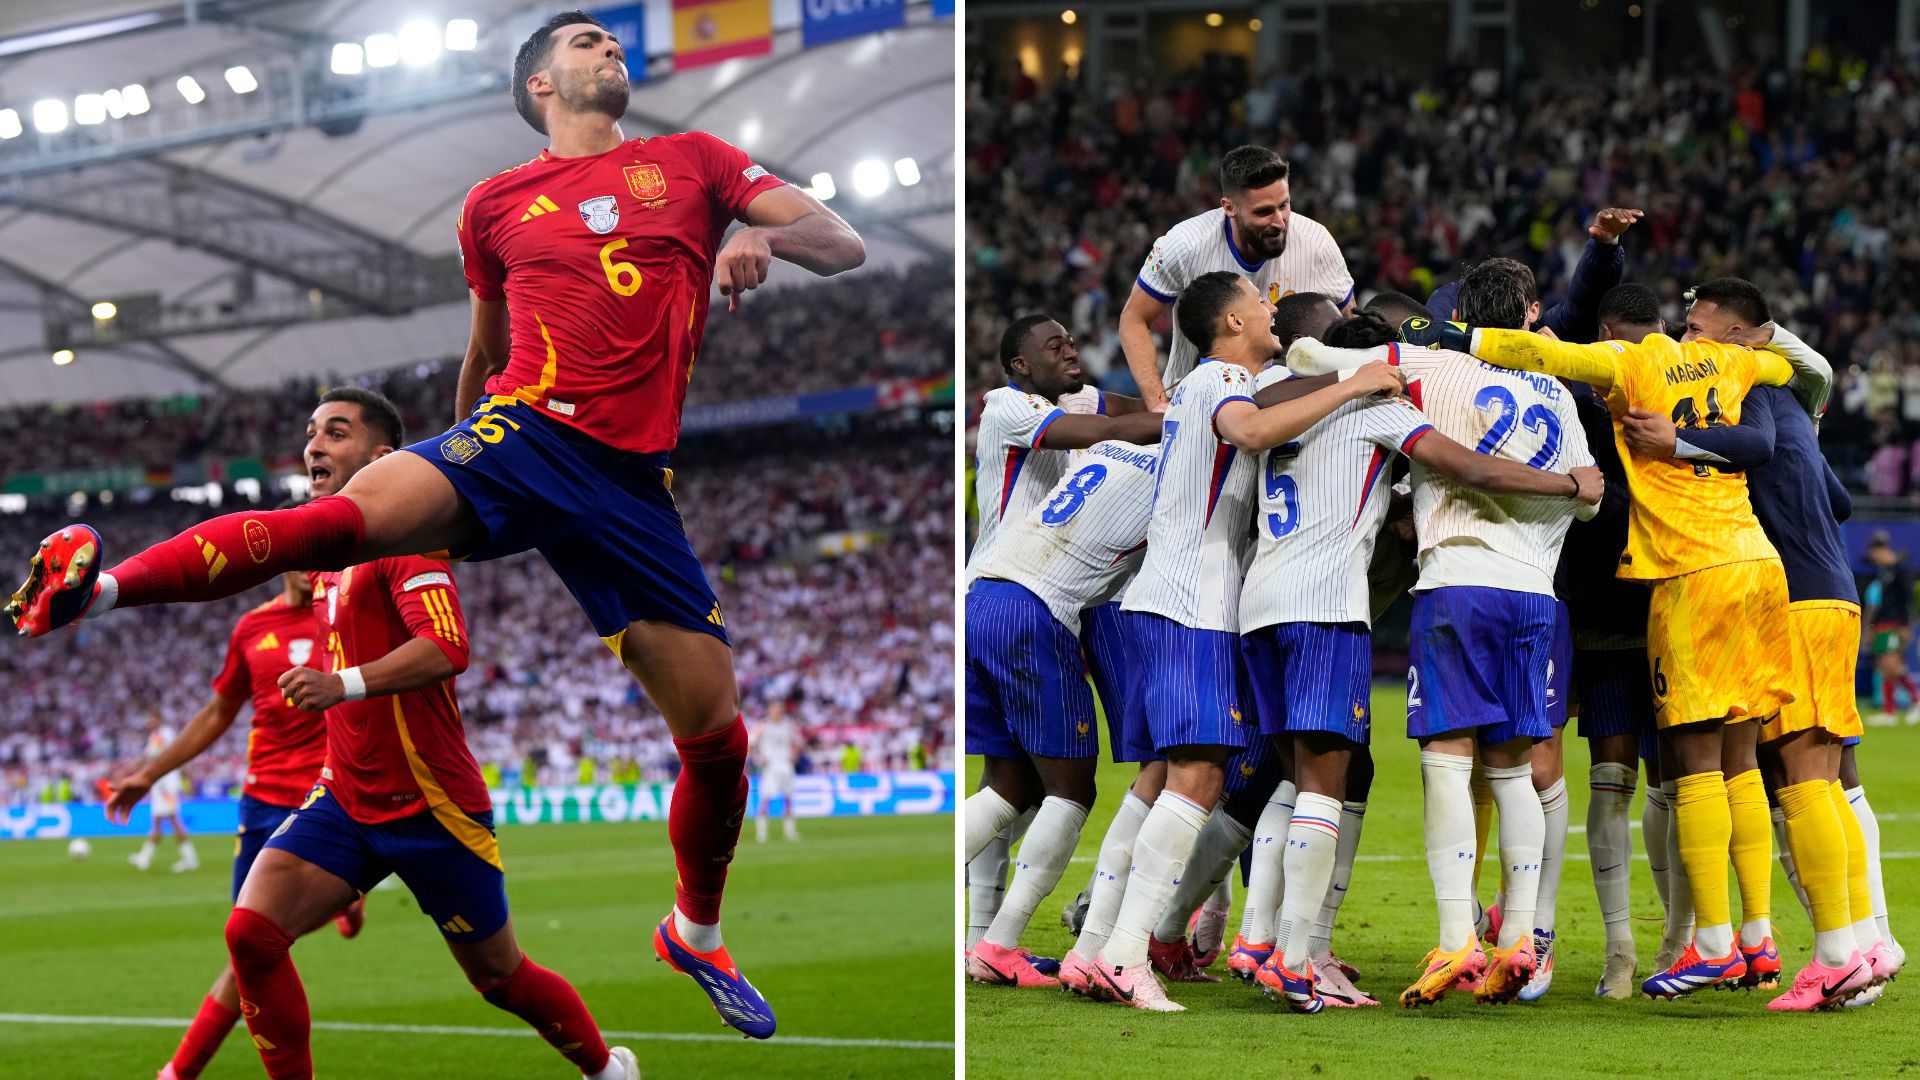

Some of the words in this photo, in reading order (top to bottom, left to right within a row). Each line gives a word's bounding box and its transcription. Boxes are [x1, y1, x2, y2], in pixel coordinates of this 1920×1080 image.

[600, 238, 642, 296] 6
[470, 413, 521, 444] 6
[1474, 386, 1563, 471] 22
[1042, 464, 1107, 528] 8
[1265, 441, 1301, 539] 5
[1408, 665, 1422, 707] 2
[1654, 657, 1668, 697] 6
[490, 784, 676, 825] TUTTGA
[787, 773, 945, 817] BYD
[0, 802, 72, 840] YD
